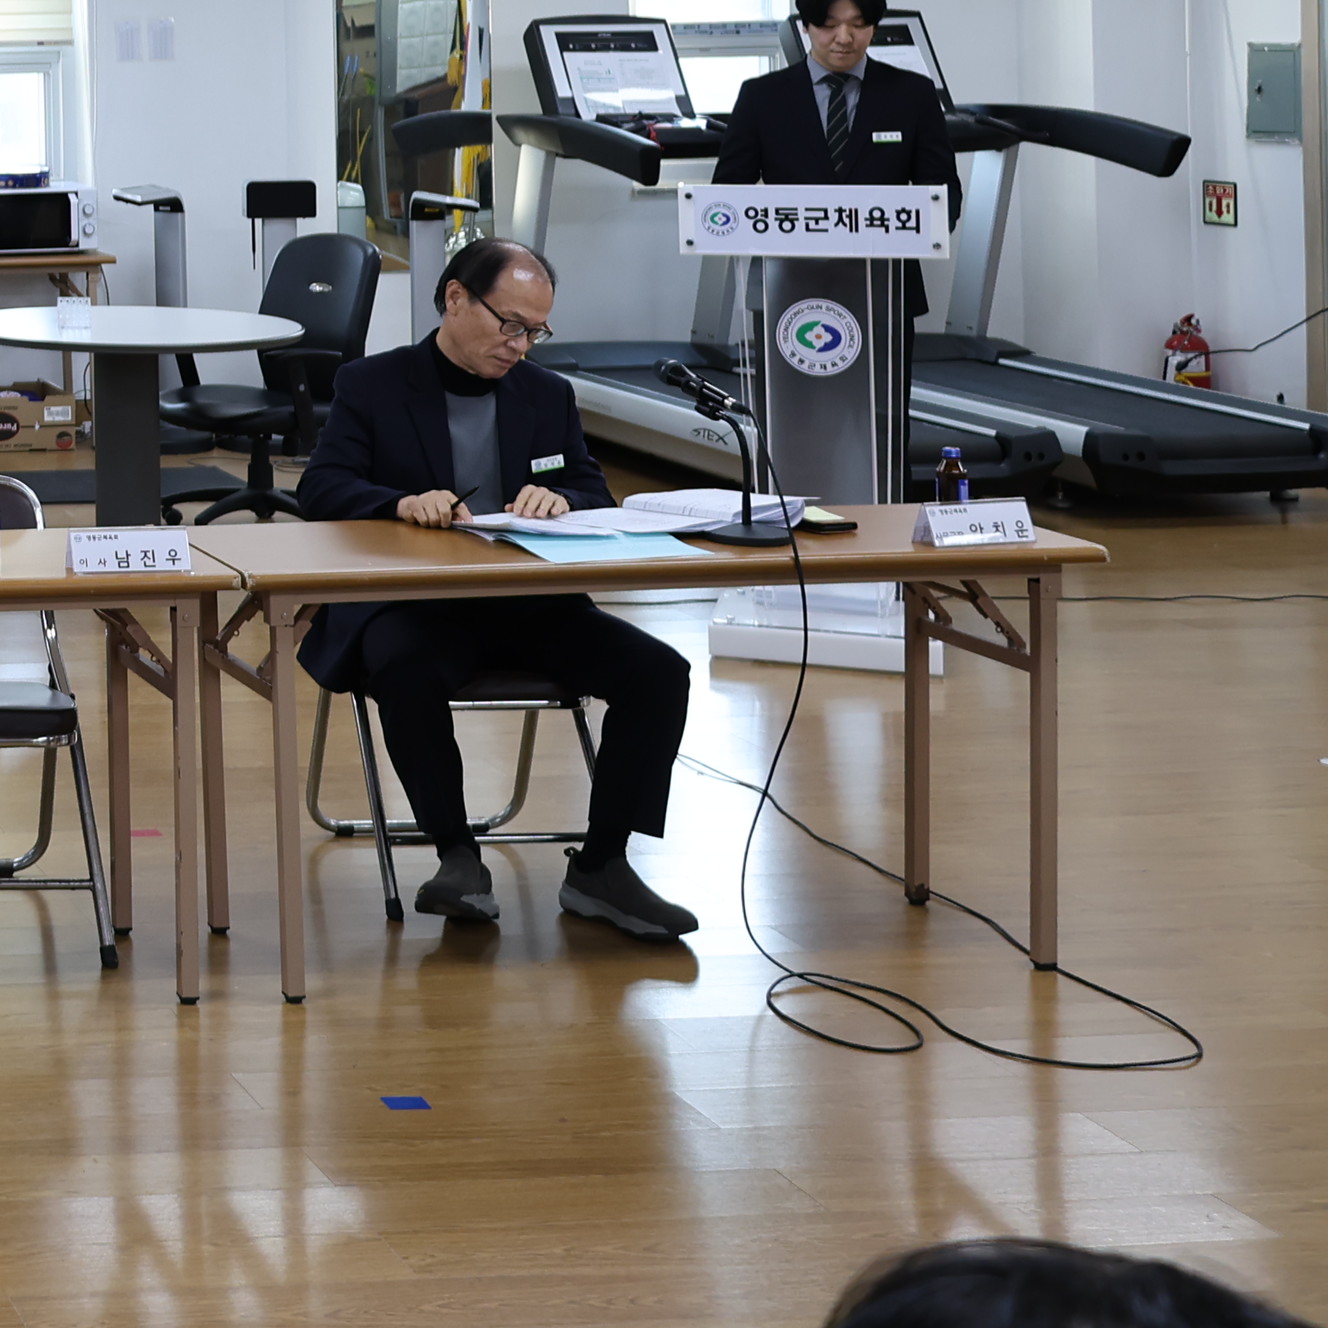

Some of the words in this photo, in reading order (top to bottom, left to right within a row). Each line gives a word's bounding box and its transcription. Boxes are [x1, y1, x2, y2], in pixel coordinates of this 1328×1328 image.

[744, 206, 922, 234] 영동군체육회
[825, 305, 848, 321] SPORT
[691, 428, 734, 446] STEX
[114, 549, 182, 569] 남진우
